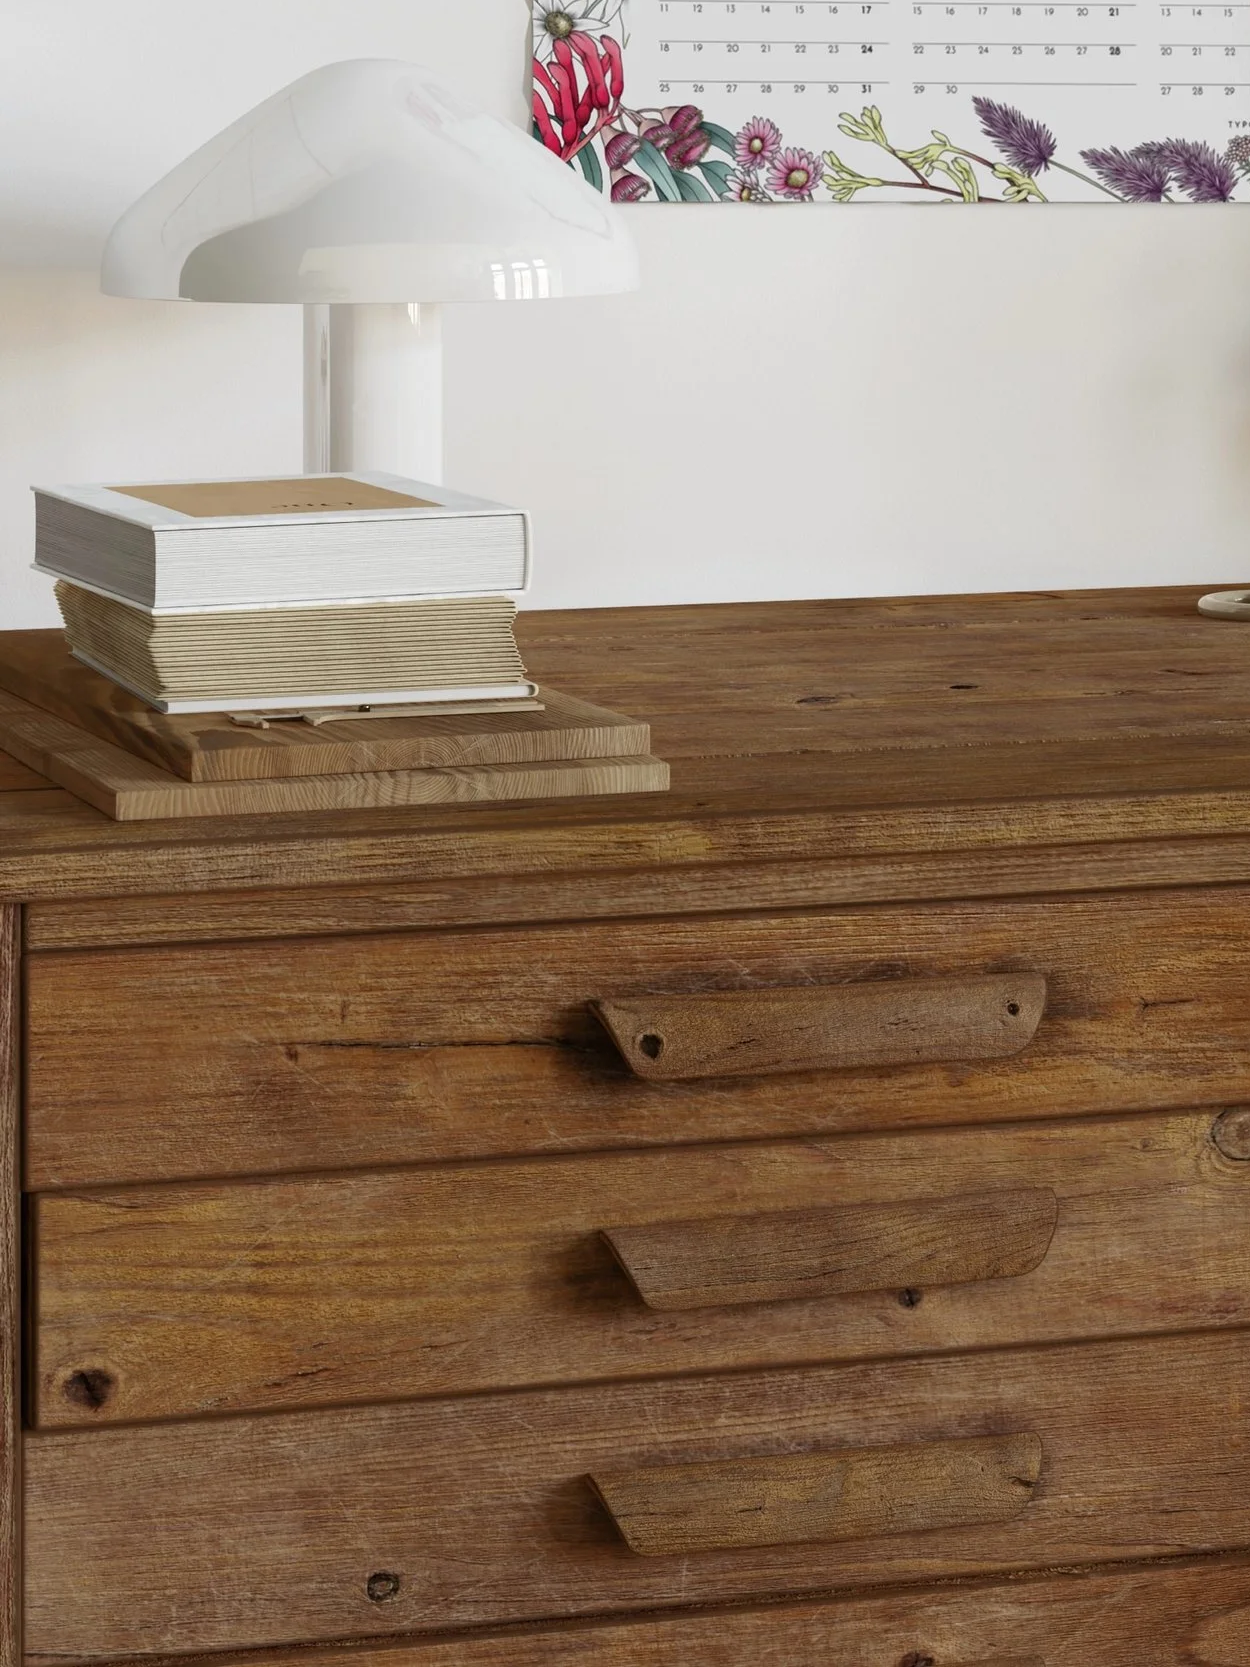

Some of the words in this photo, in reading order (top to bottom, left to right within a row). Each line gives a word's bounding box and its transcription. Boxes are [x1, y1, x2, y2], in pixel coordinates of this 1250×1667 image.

[659, 3, 669, 13] 11
[692, 3, 703, 14] 12
[725, 3, 736, 14] 13
[760, 4, 771, 14] 14
[795, 4, 805, 15] 15
[828, 5, 839, 15] 16
[861, 4, 873, 15] 17
[1108, 6, 1120, 17] 21
[1160, 7, 1172, 18] 13
[1191, 8, 1203, 17] 14
[1223, 7, 1233, 18] 15
[860, 44, 874, 54] 24
[1108, 45, 1122, 56] 28
[861, 83, 872, 94] 31
[913, 84, 926, 95] 29
